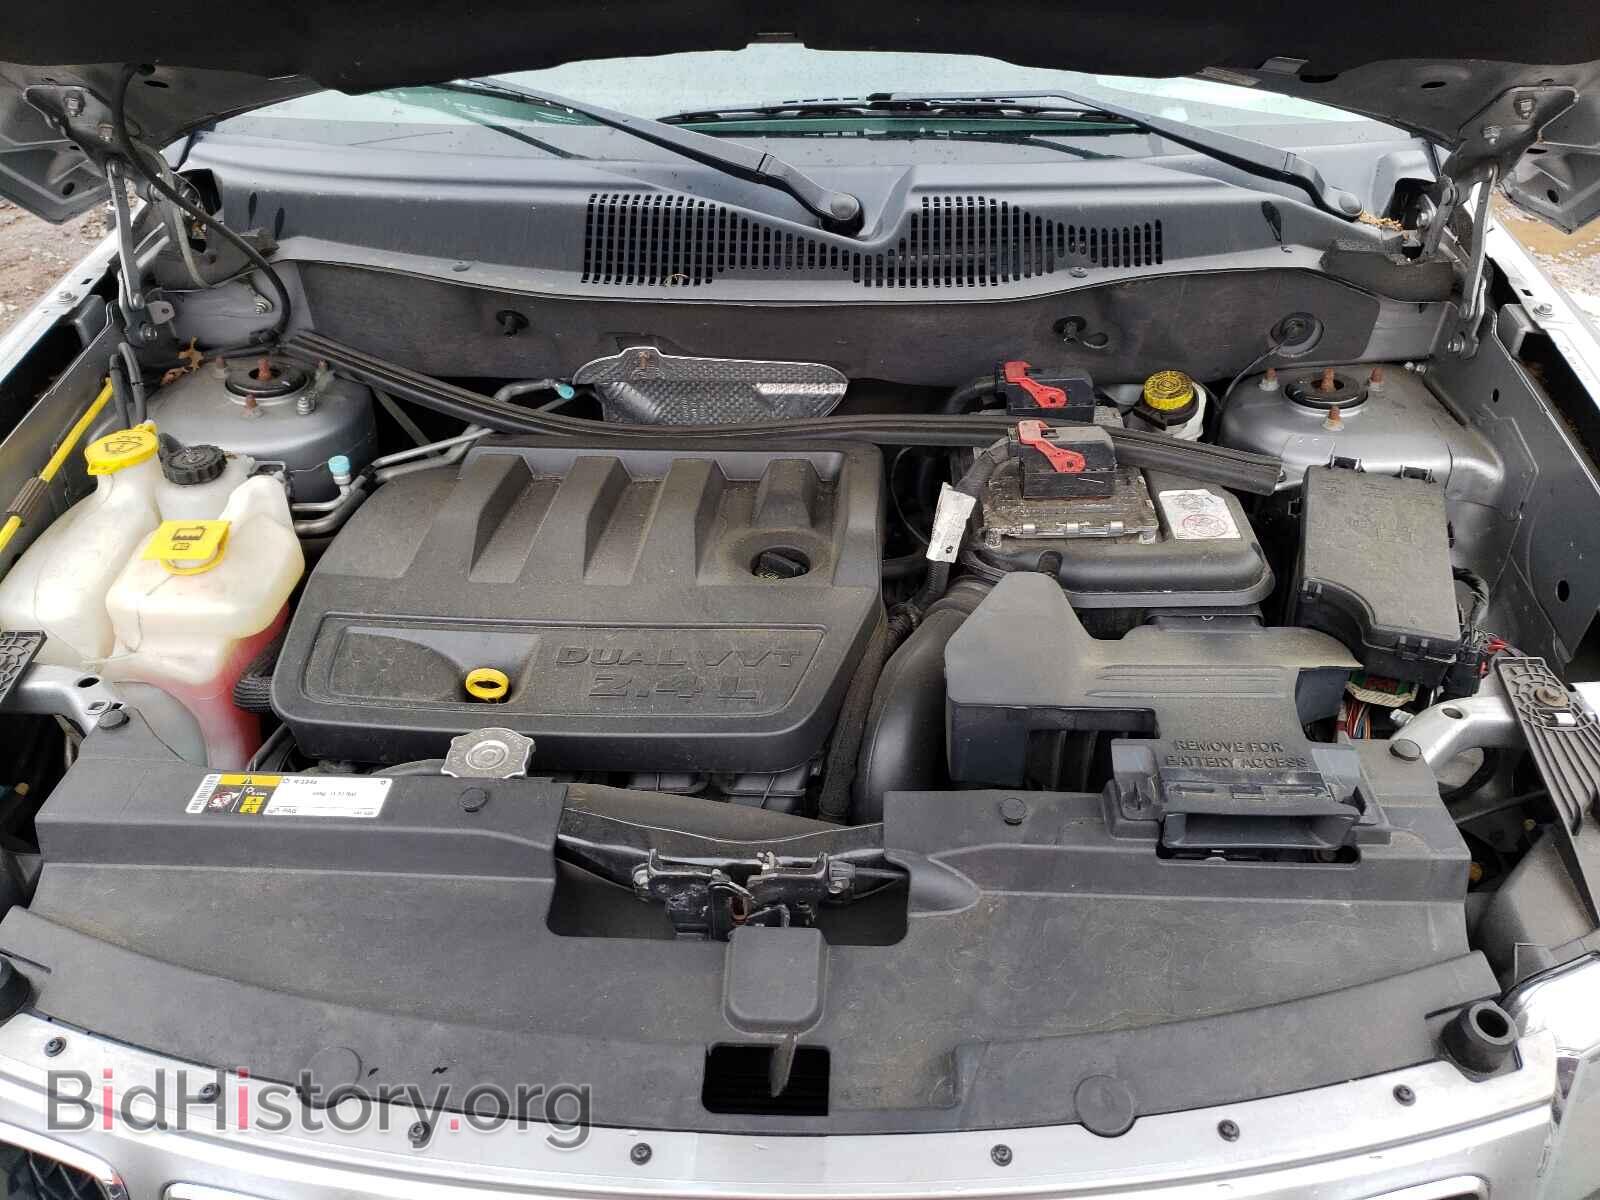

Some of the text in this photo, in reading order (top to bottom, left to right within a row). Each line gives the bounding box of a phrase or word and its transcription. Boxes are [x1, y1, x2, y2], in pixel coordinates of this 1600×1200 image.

[555, 647, 801, 668] DUAL VVT
[1175, 739, 1284, 754] REMOVE FOR
[1166, 753, 1309, 770] BATTERY ACCESS
